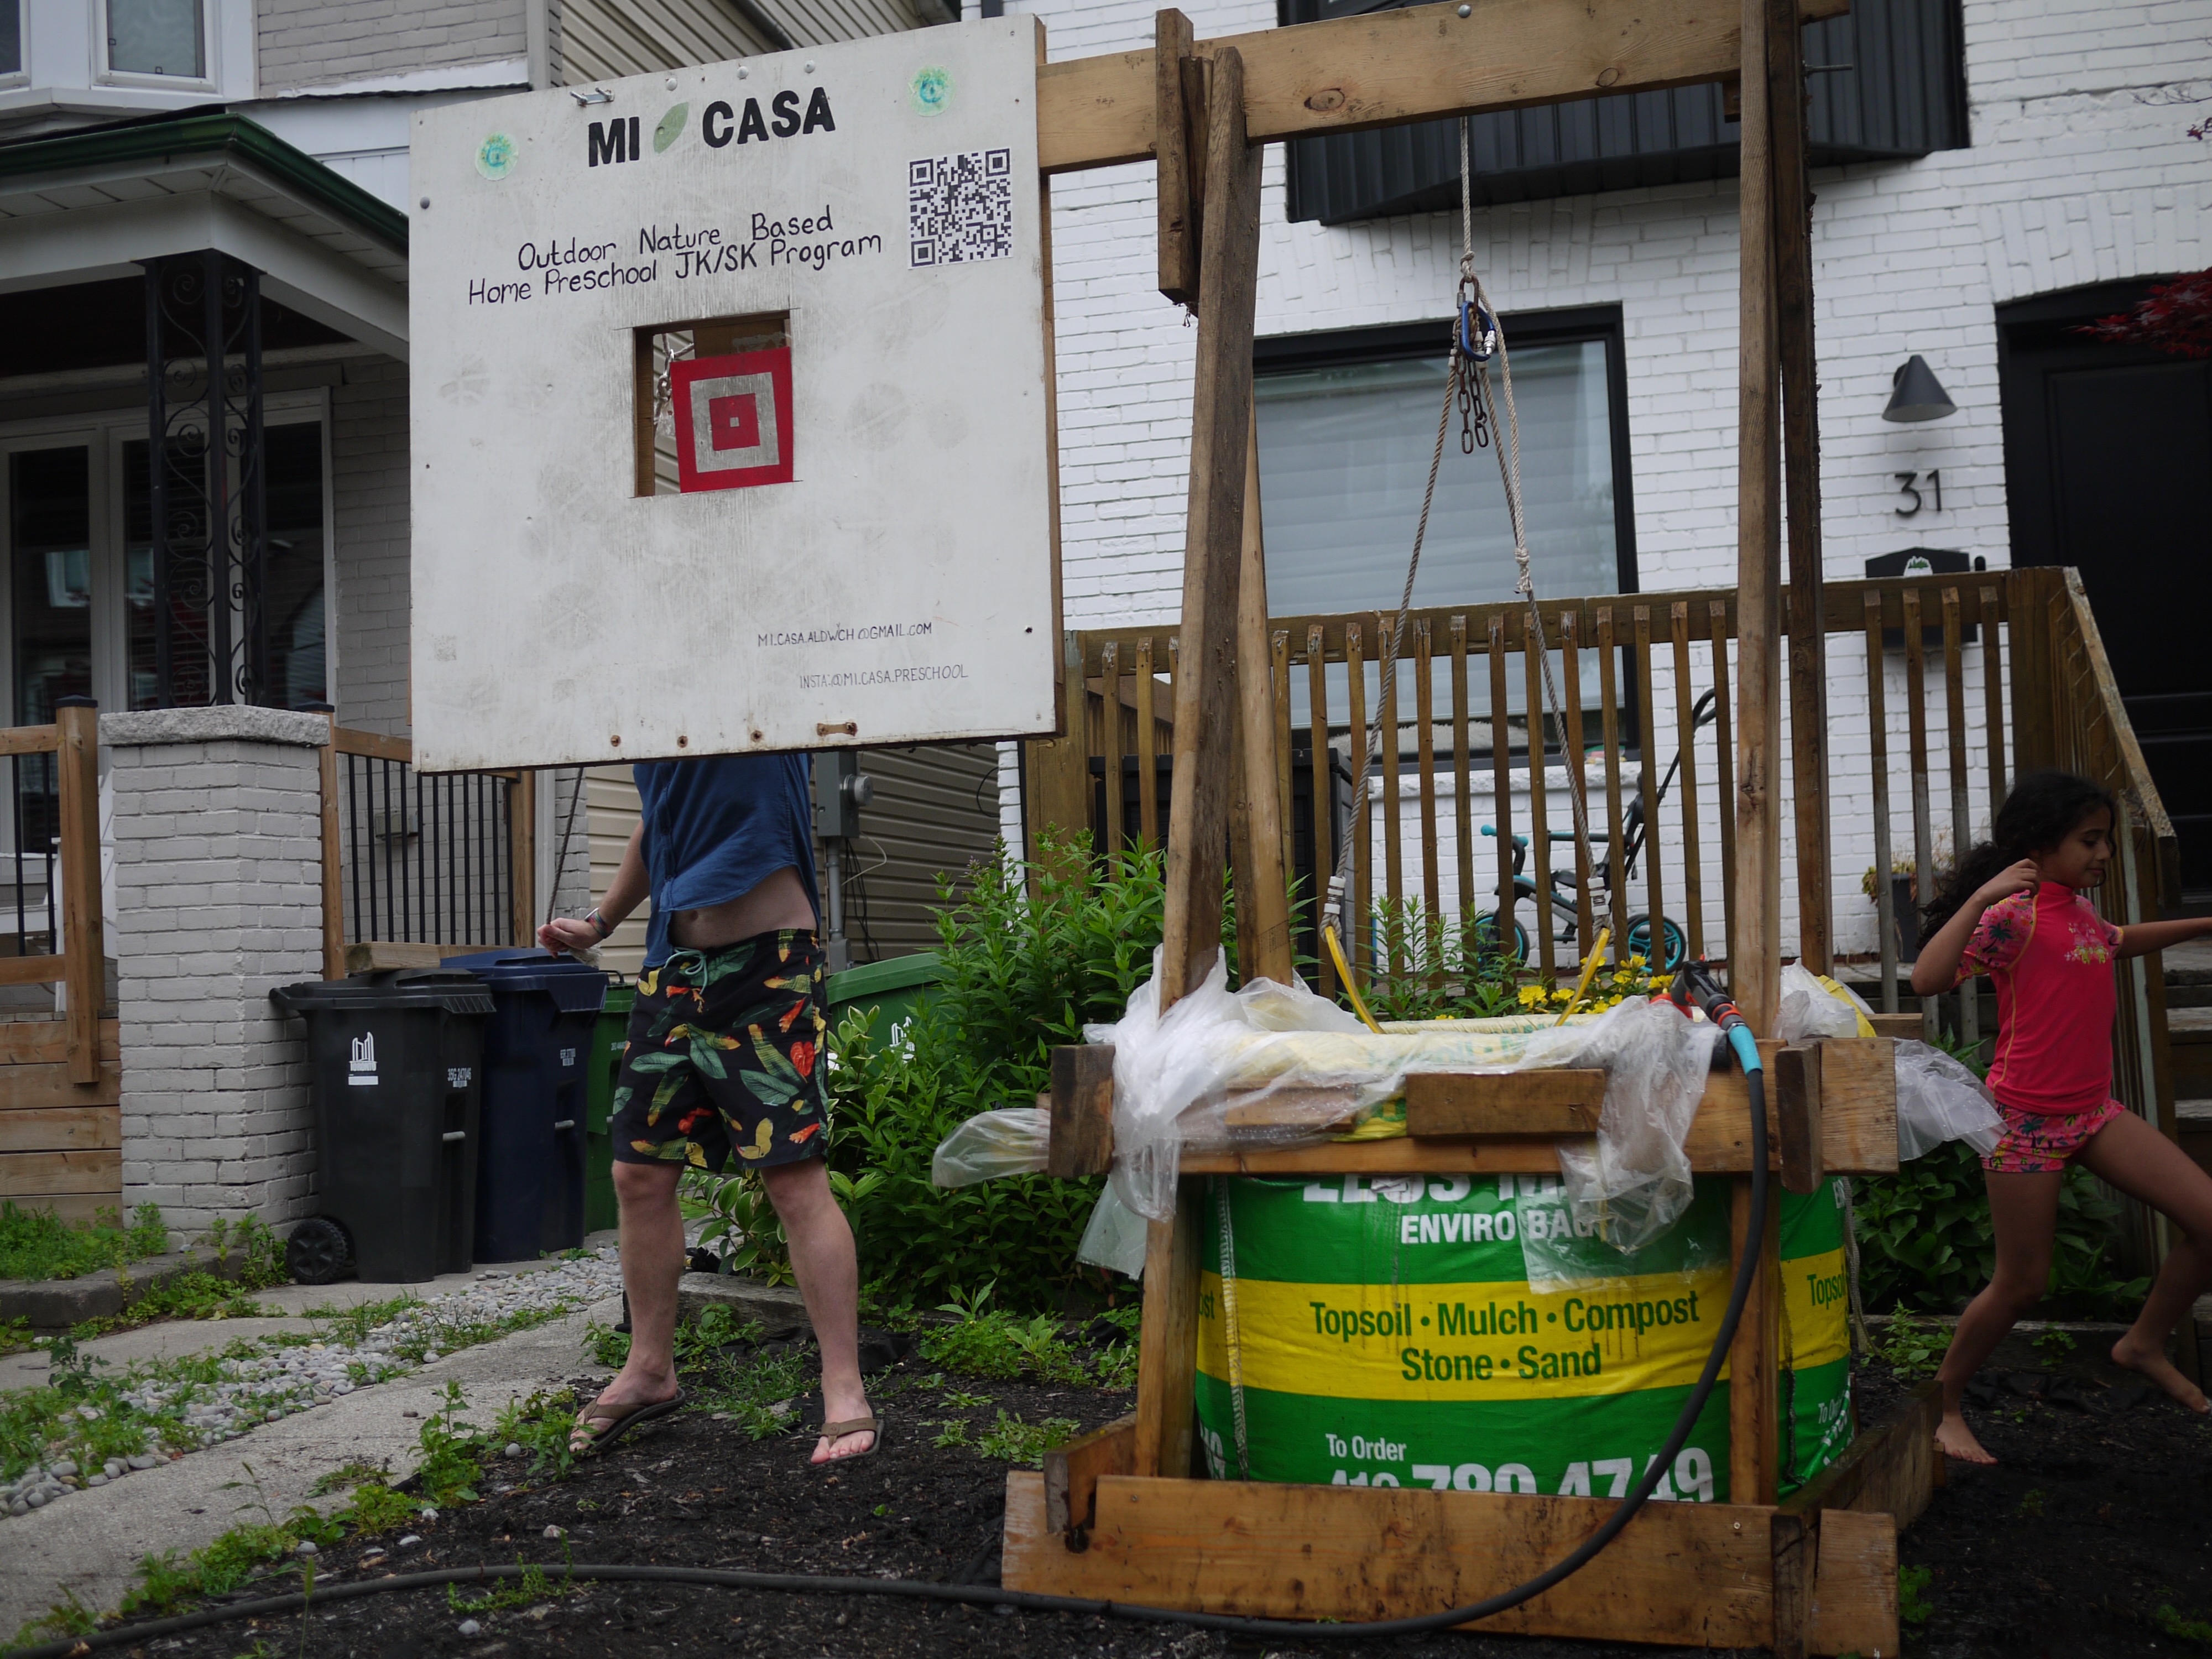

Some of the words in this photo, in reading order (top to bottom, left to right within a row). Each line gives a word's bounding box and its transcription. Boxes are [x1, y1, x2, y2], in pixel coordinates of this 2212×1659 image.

[589, 117, 640, 167] MI
[703, 87, 836, 148] CASA
[519, 237, 617, 270] Outdoor
[639, 223, 721, 254] Nature
[751, 204, 833, 241] Based
[469, 278, 531, 305] Home
[544, 259, 656, 295] Preschool
[675, 242, 758, 279] JK/SK
[770, 234, 882, 271] Program
[1894, 468, 1942, 517] 31
[1401, 1210, 1516, 1244] ENVIRO
[1309, 1301, 1412, 1342] Topsoil
[1438, 1301, 1538, 1337] Mulch
[1564, 1290, 1700, 1335] Compost
[1401, 1346, 1493, 1381] Stone
[1518, 1343, 1601, 1379] Sand
[1325, 1433, 1348, 1458] To
[1352, 1434, 1407, 1462] Order
